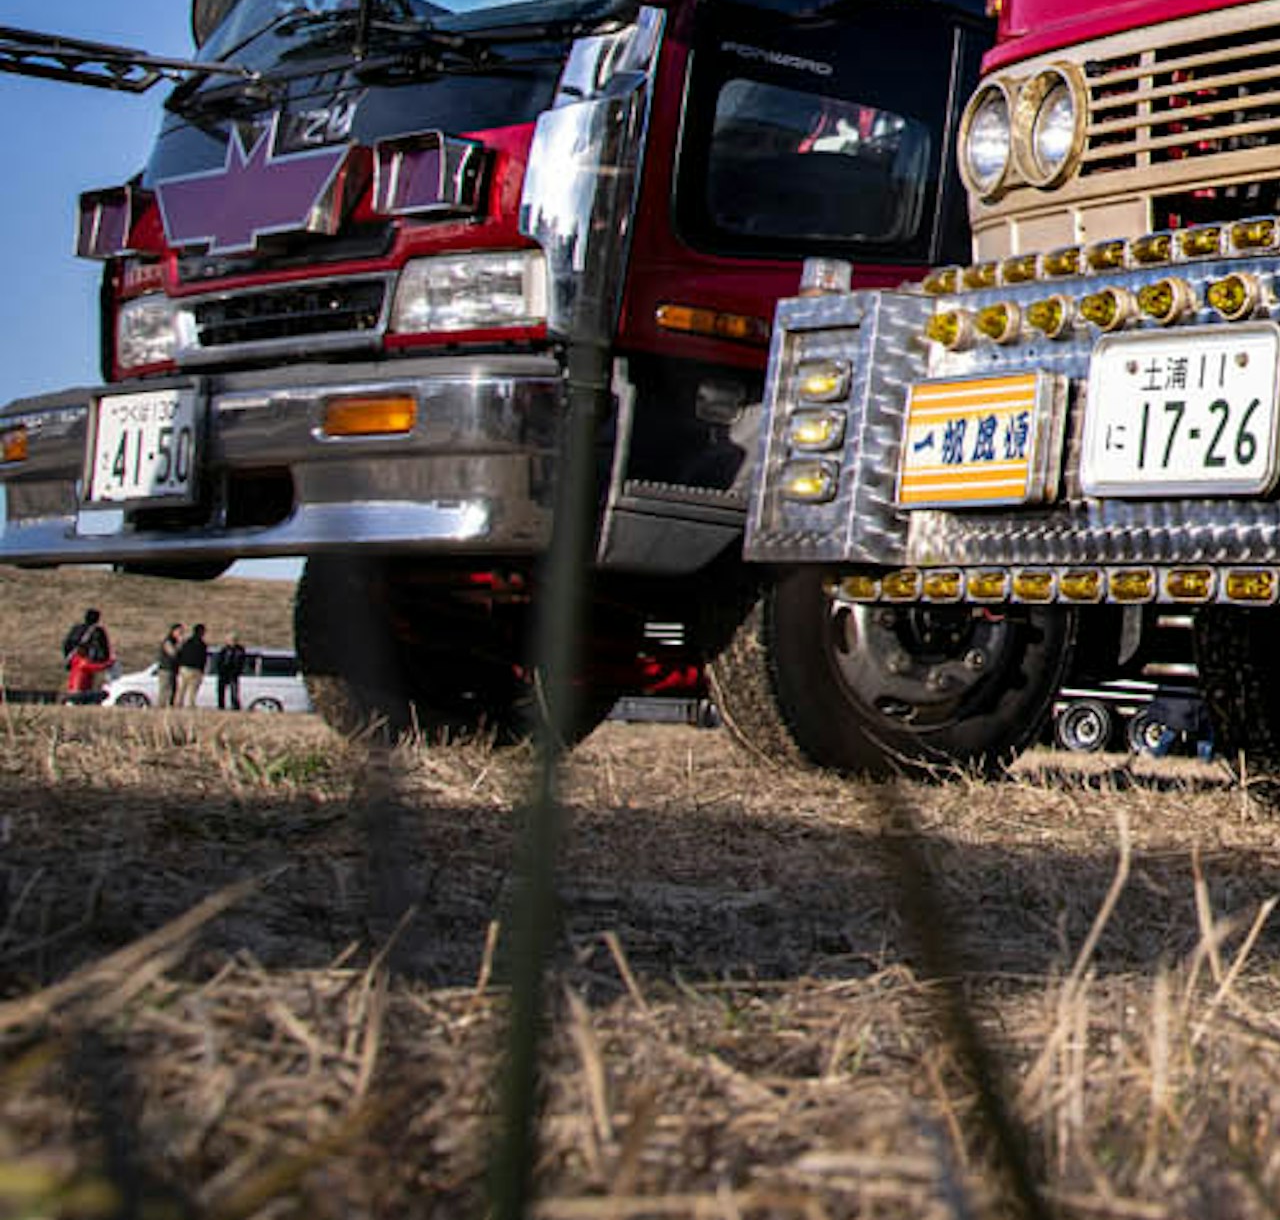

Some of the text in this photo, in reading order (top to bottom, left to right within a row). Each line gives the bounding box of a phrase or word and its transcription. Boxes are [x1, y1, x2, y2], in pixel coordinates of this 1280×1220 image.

[1140, 352, 1227, 392] 土浦 11
[112, 425, 192, 488] 41-50
[1105, 396, 1261, 470] に 17-26
